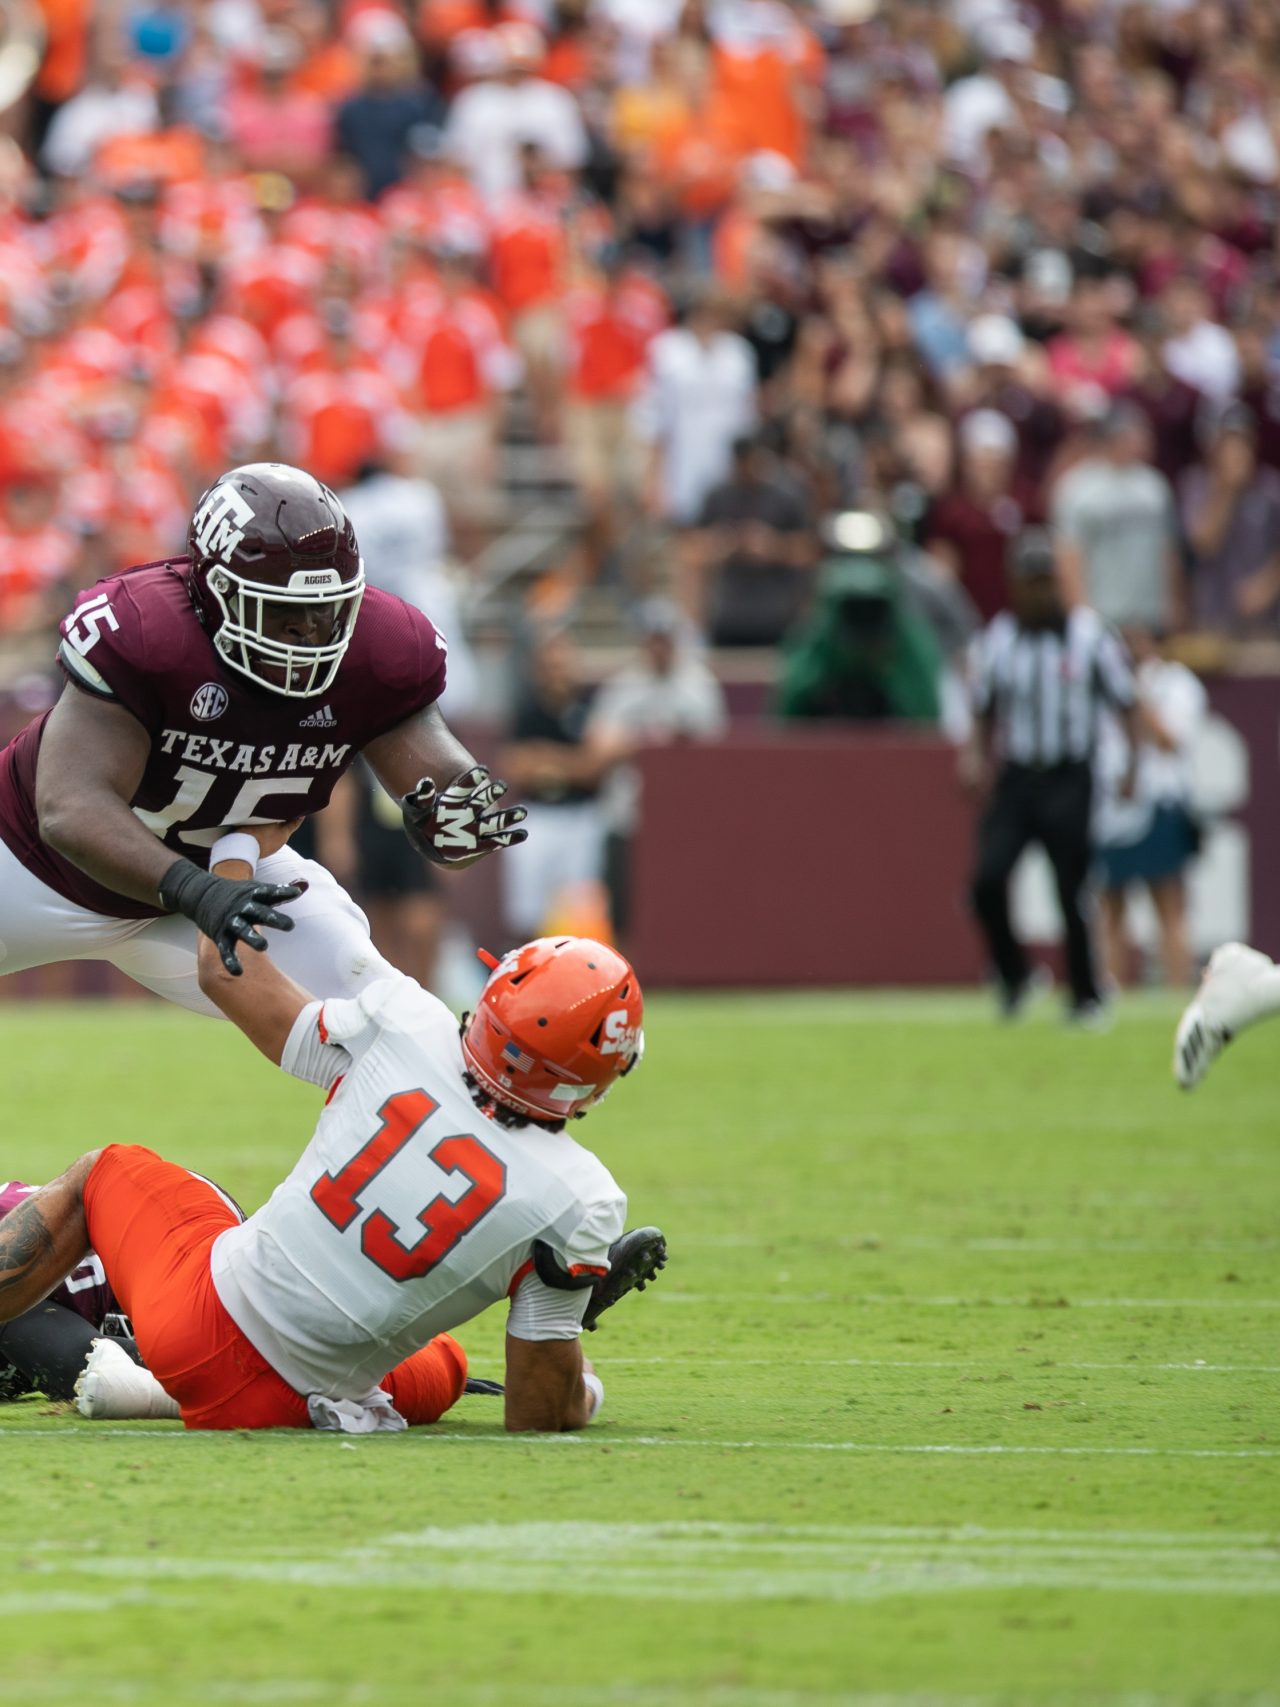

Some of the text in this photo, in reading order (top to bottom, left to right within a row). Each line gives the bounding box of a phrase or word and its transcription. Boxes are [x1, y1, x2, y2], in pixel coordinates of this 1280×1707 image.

[304, 575, 332, 585] AGGIES
[65, 592, 120, 656] 15
[193, 683, 223, 719] SEC
[299, 718, 338, 728] adidas
[161, 729, 352, 773] TEXAS A&M
[131, 764, 314, 848] 15
[310, 1088, 507, 1283] 13
